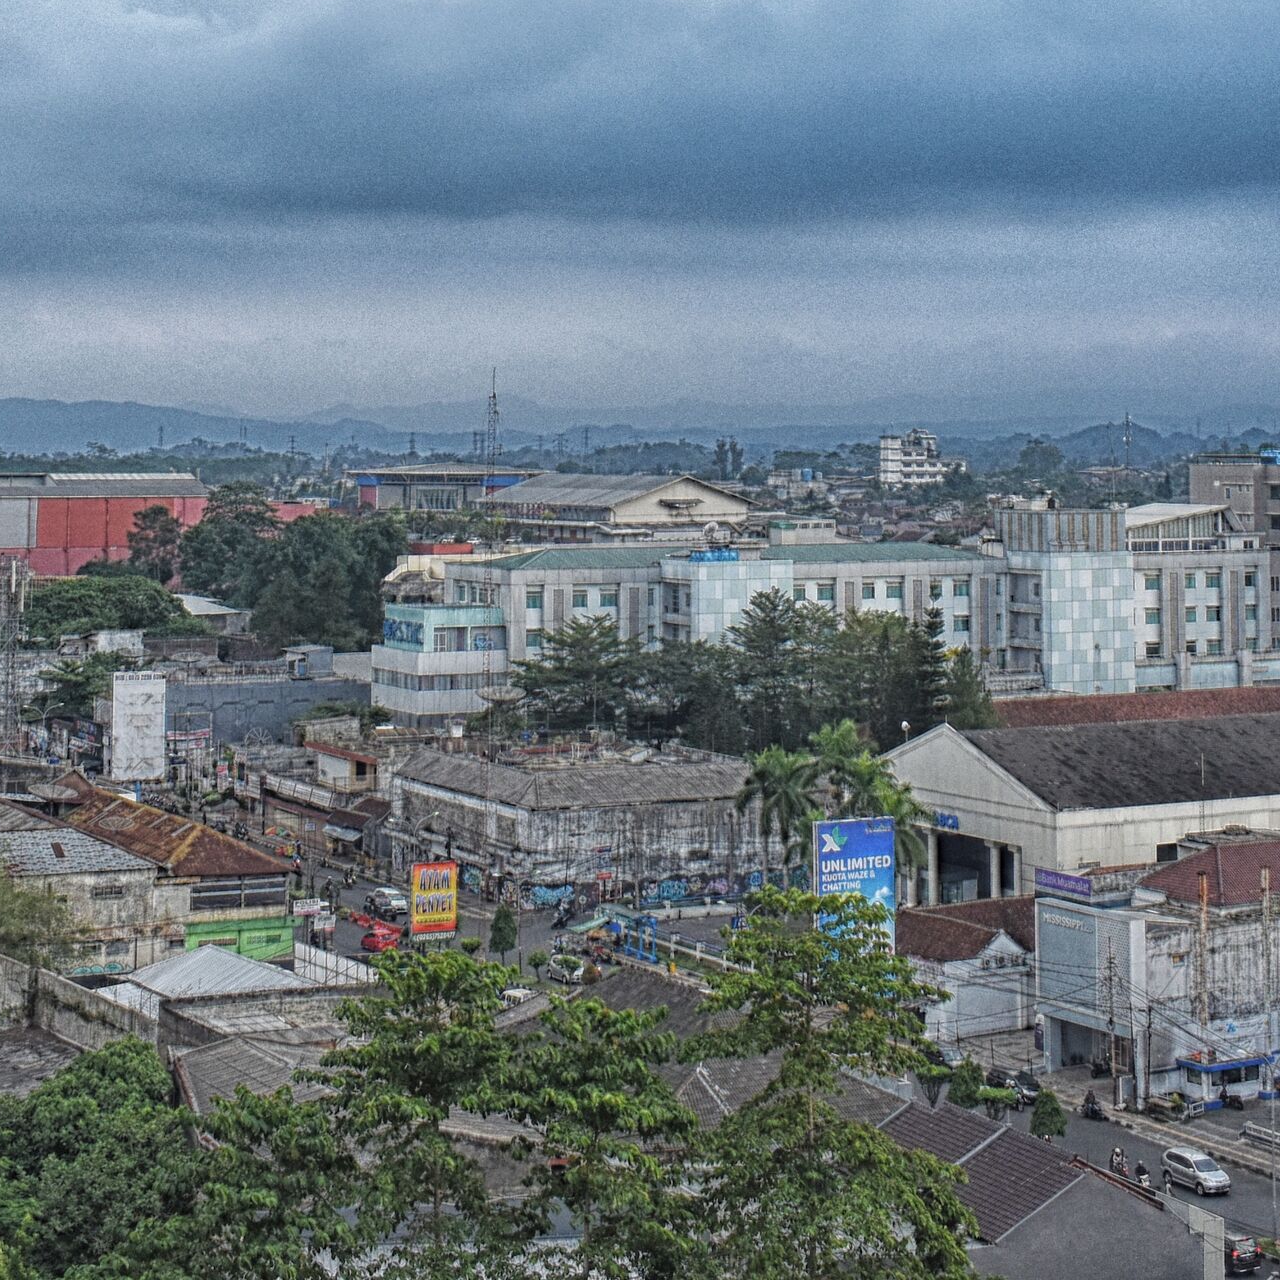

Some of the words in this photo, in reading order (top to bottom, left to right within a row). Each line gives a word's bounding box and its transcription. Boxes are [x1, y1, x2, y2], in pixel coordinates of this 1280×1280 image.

[822, 855, 891, 873] UNLIMITED
[419, 868, 450, 892] AYAM
[822, 873, 846, 883] KUOTA
[847, 871, 868, 880] WAZE
[870, 869, 876, 878] &
[1041, 871, 1058, 885] Bank
[822, 881, 861, 892] CHATTING
[415, 893, 454, 914] PENYET
